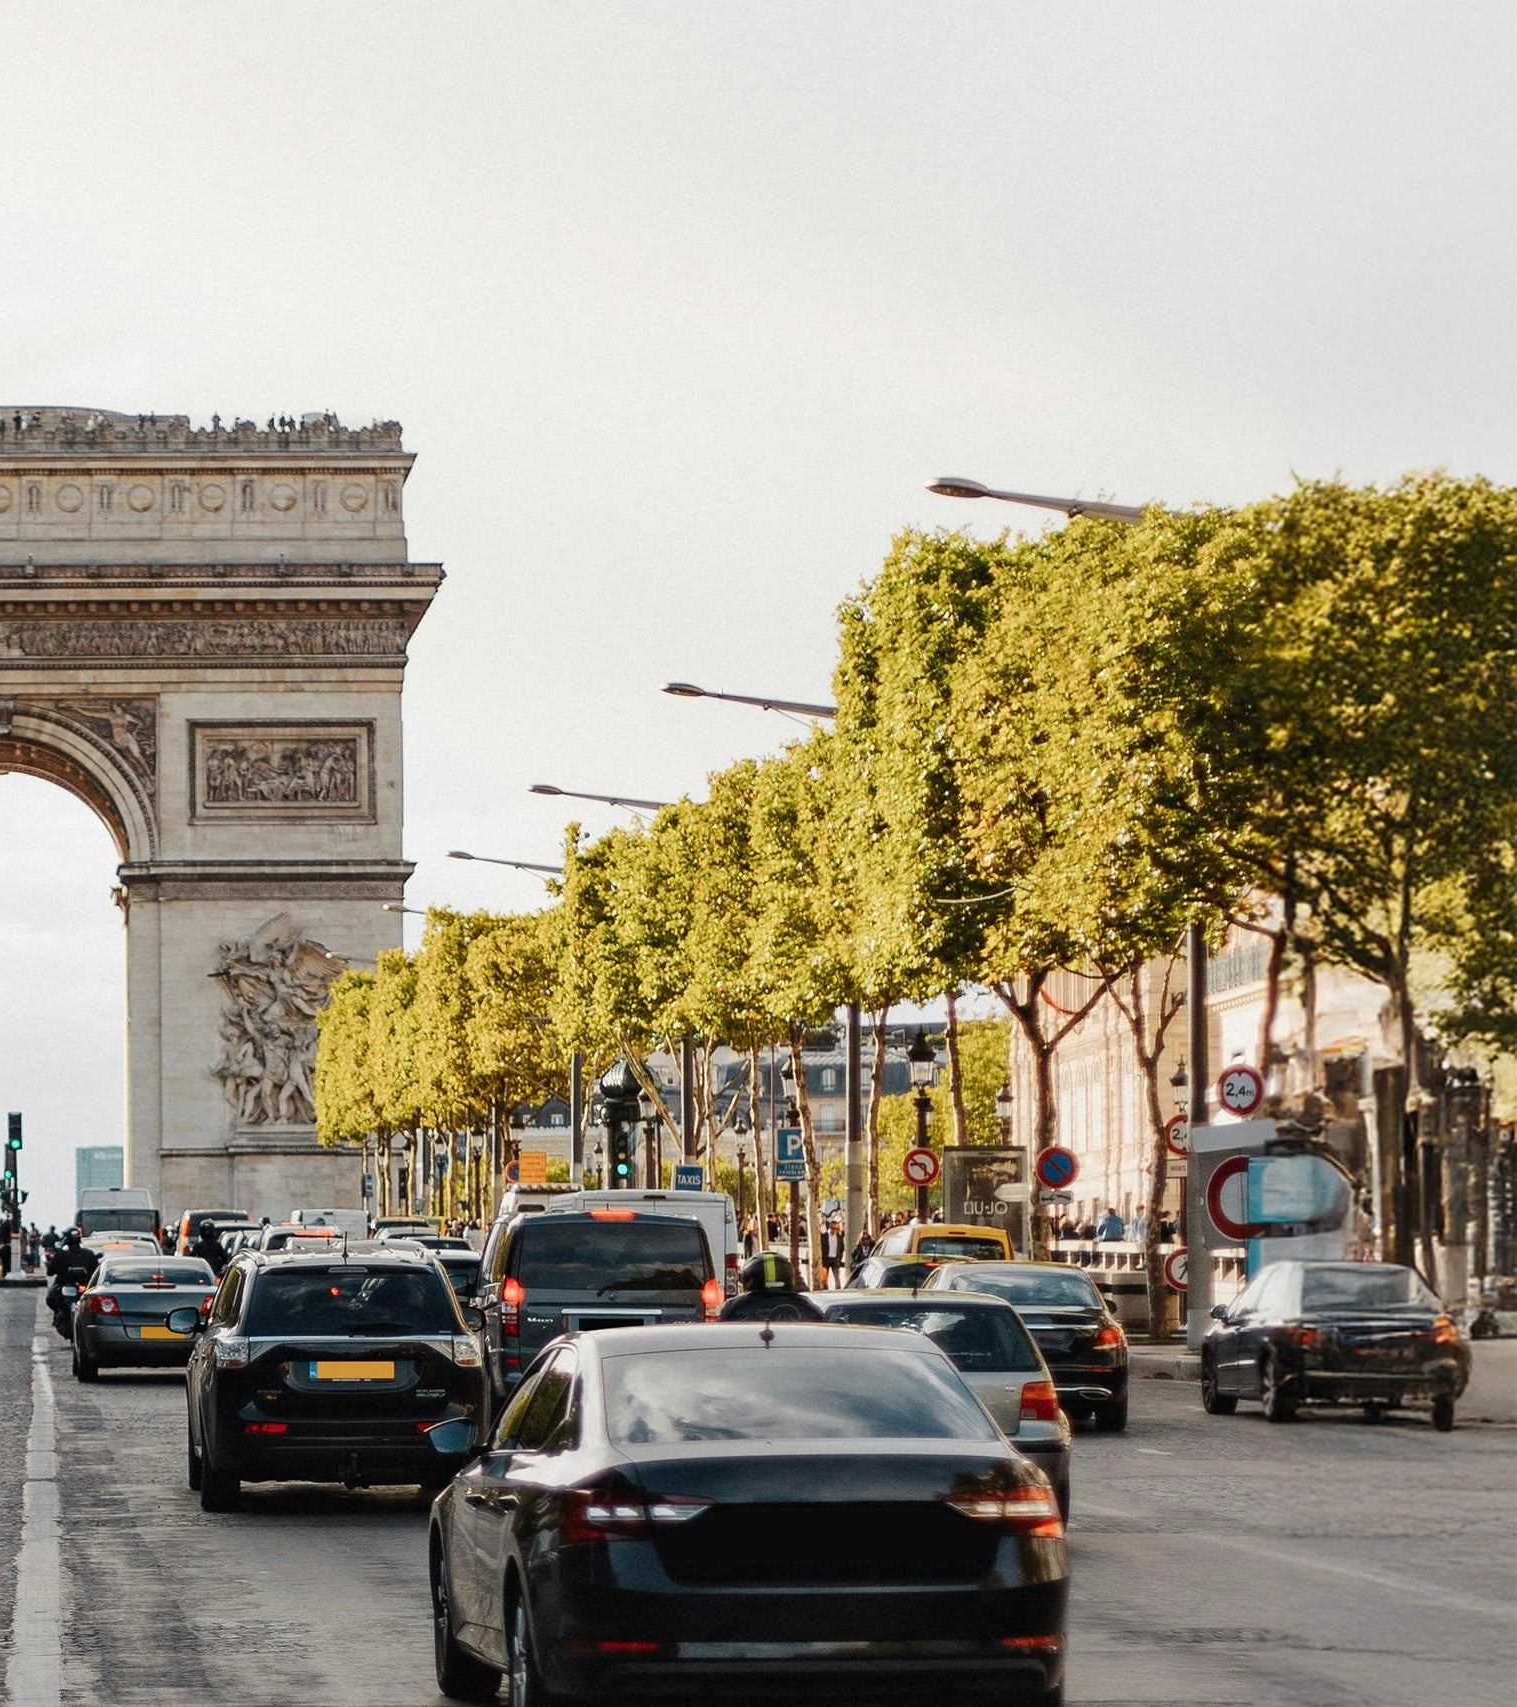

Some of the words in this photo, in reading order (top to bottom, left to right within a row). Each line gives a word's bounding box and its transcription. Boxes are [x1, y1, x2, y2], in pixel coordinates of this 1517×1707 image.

[1226, 1083, 1254, 1098] 2,4m
[787, 1135, 802, 1156] P
[677, 1175, 701, 1185] TAXIS
